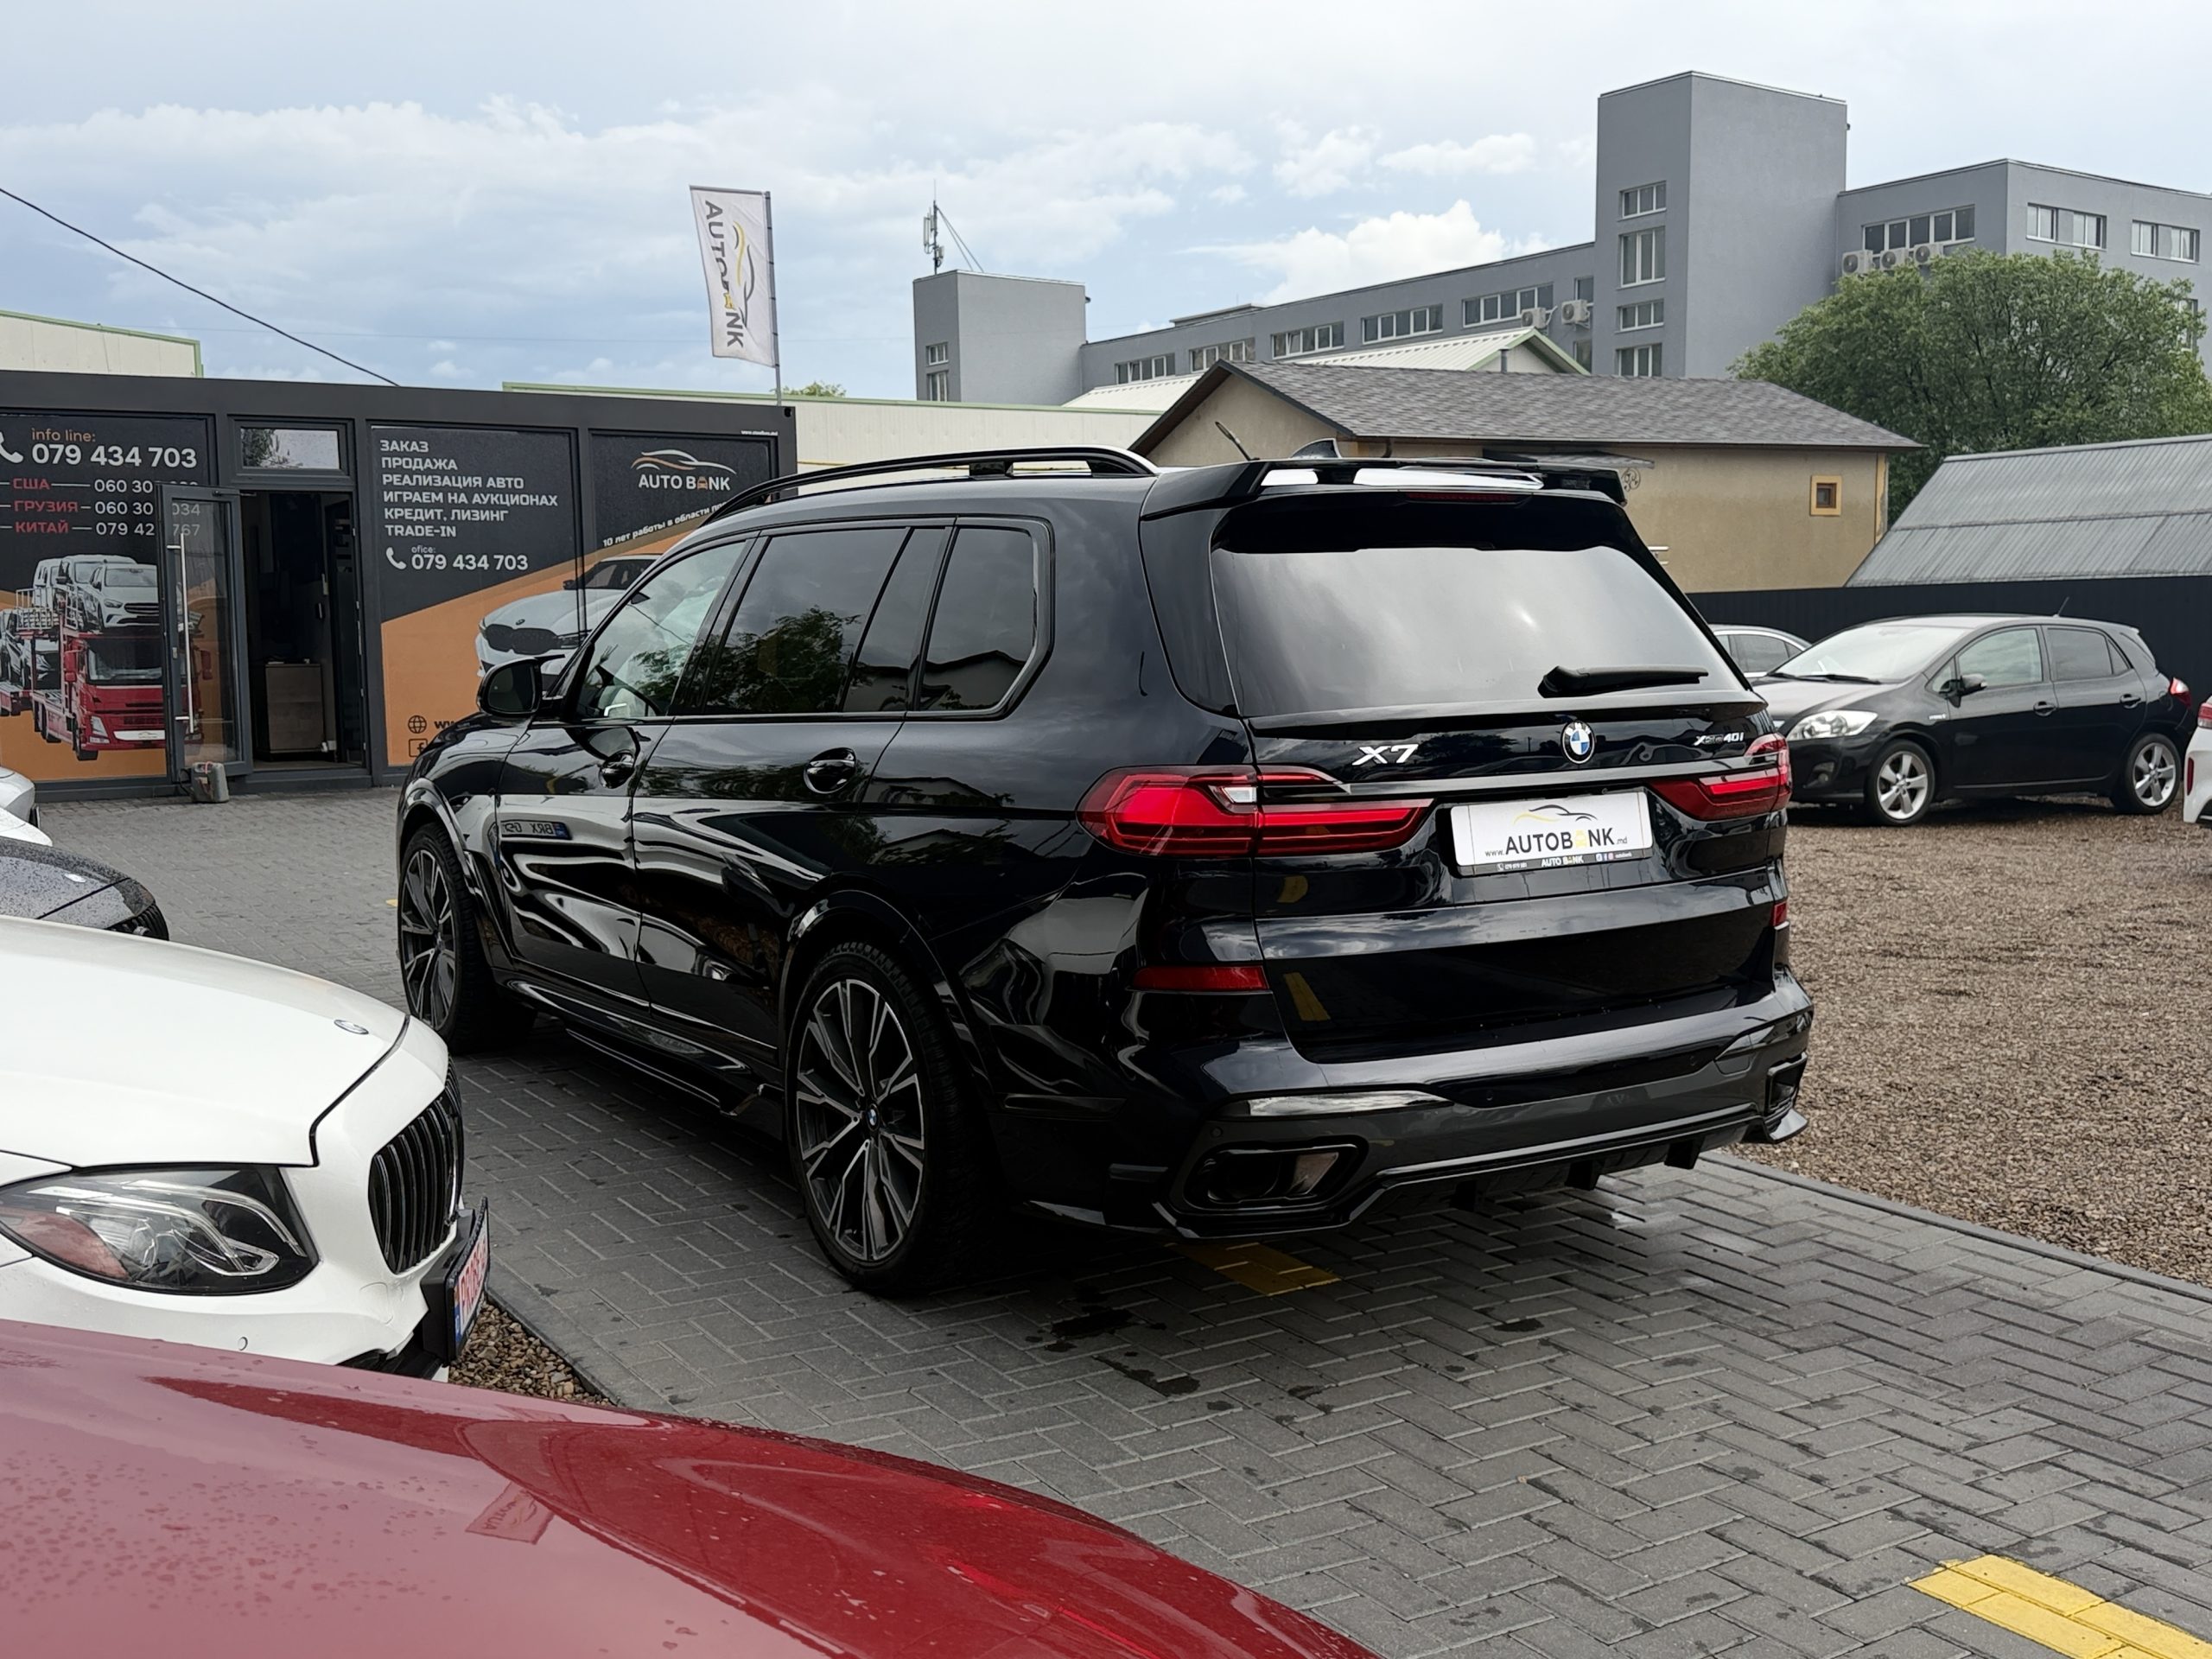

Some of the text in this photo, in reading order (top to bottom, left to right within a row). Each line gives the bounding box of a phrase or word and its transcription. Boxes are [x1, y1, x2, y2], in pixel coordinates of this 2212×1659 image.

[31, 427, 97, 443] info line:
[379, 439, 429, 453] ЗАКАЗ
[31, 442, 198, 469] 079 434 703
[381, 456, 458, 471] ПРОДАЖА
[12, 478, 50, 491] США
[94, 479, 128, 493] 060
[382, 474, 524, 489] РЕАЛИЗАЦИЯ АВТО
[639, 474, 683, 490] AUTO
[383, 491, 559, 506] ИГРАЕМ НА АУКЦИОНАХ
[13, 499, 79, 513] ГРУЗИЯ
[94, 501, 128, 515] 060
[172, 503, 201, 516] 034
[384, 507, 509, 522] КРЕДИТ, ЛИЗИНГ
[15, 519, 70, 534] КИТАЙ
[95, 522, 129, 536] 079
[173, 524, 200, 537] 767
[385, 524, 457, 537] TRADE-IN
[602, 537, 613, 547] 10
[614, 532, 632, 543] лет
[632, 521, 666, 539] работы
[674, 507, 710, 525] области
[411, 554, 529, 570] 079 434 703
[1351, 744, 1419, 766] X7
[1541, 857, 1562, 868] AUTO
